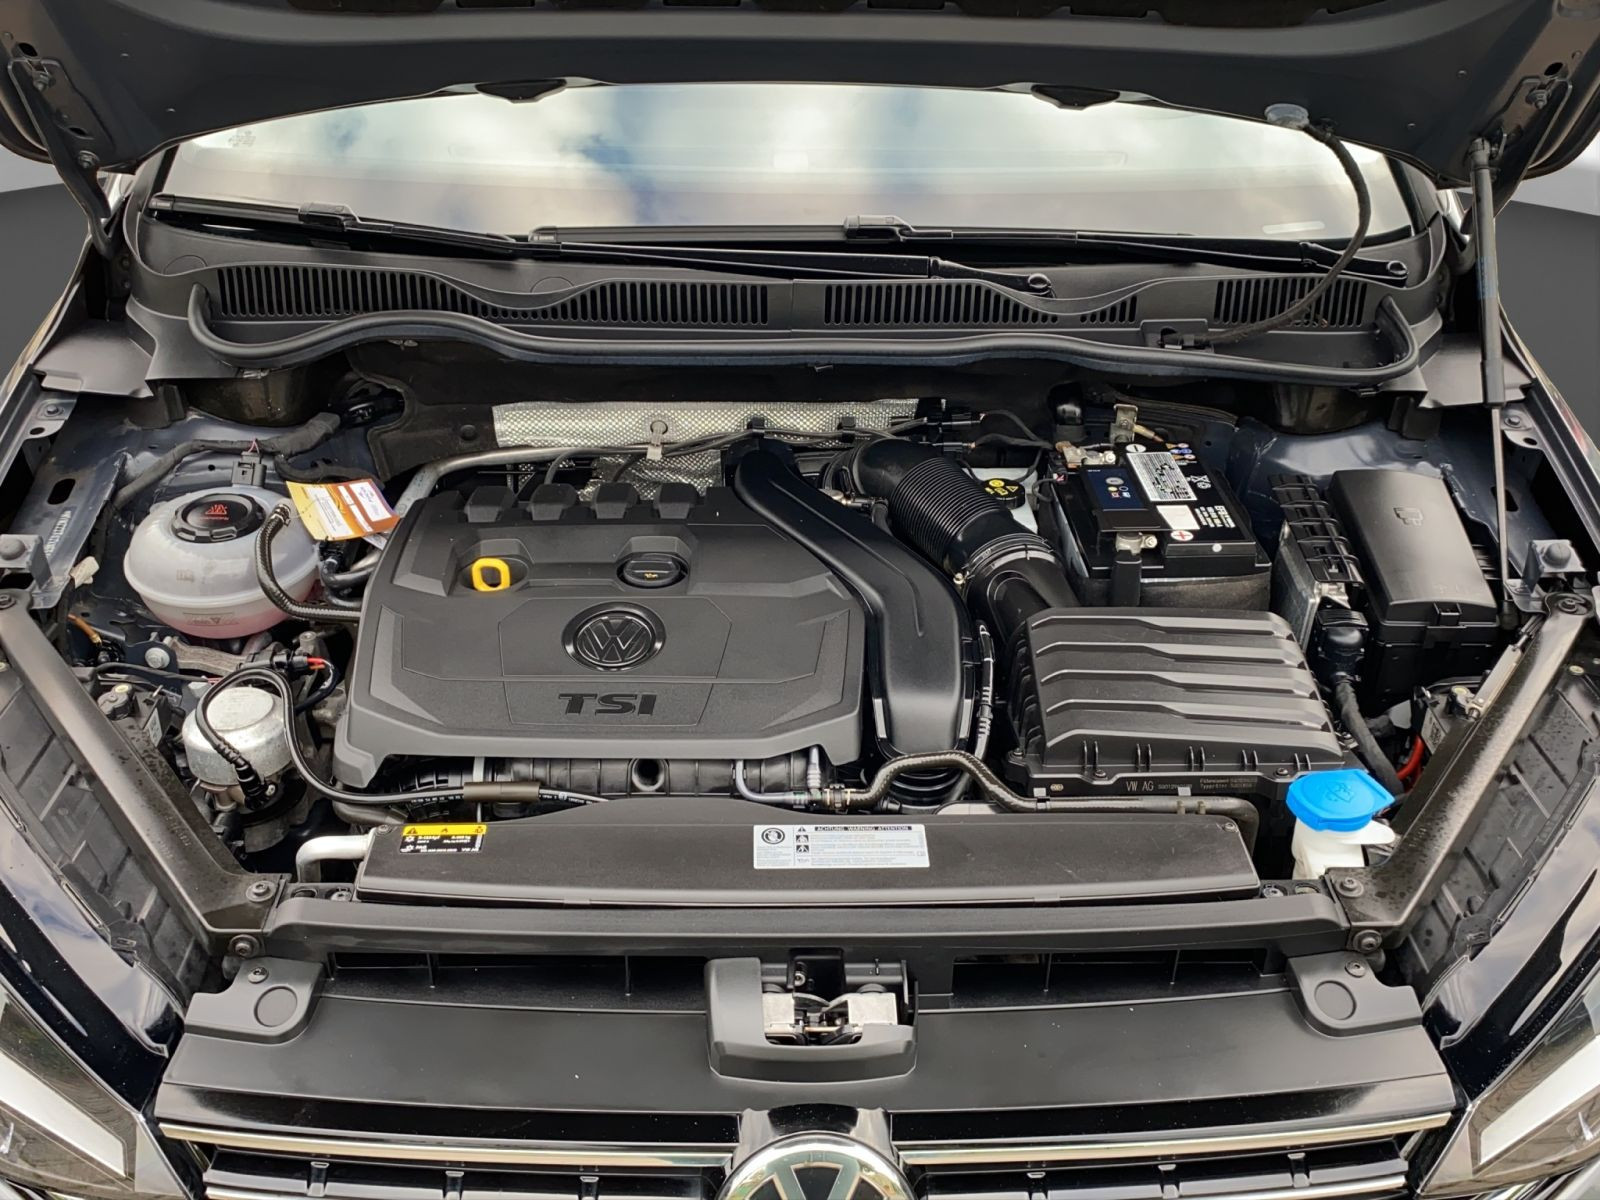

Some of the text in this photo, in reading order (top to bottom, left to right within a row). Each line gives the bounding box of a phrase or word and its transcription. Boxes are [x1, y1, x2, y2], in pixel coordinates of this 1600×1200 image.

[558, 693, 657, 715] TSI
[1126, 781, 1139, 792] VW
[1142, 781, 1154, 791] AG
